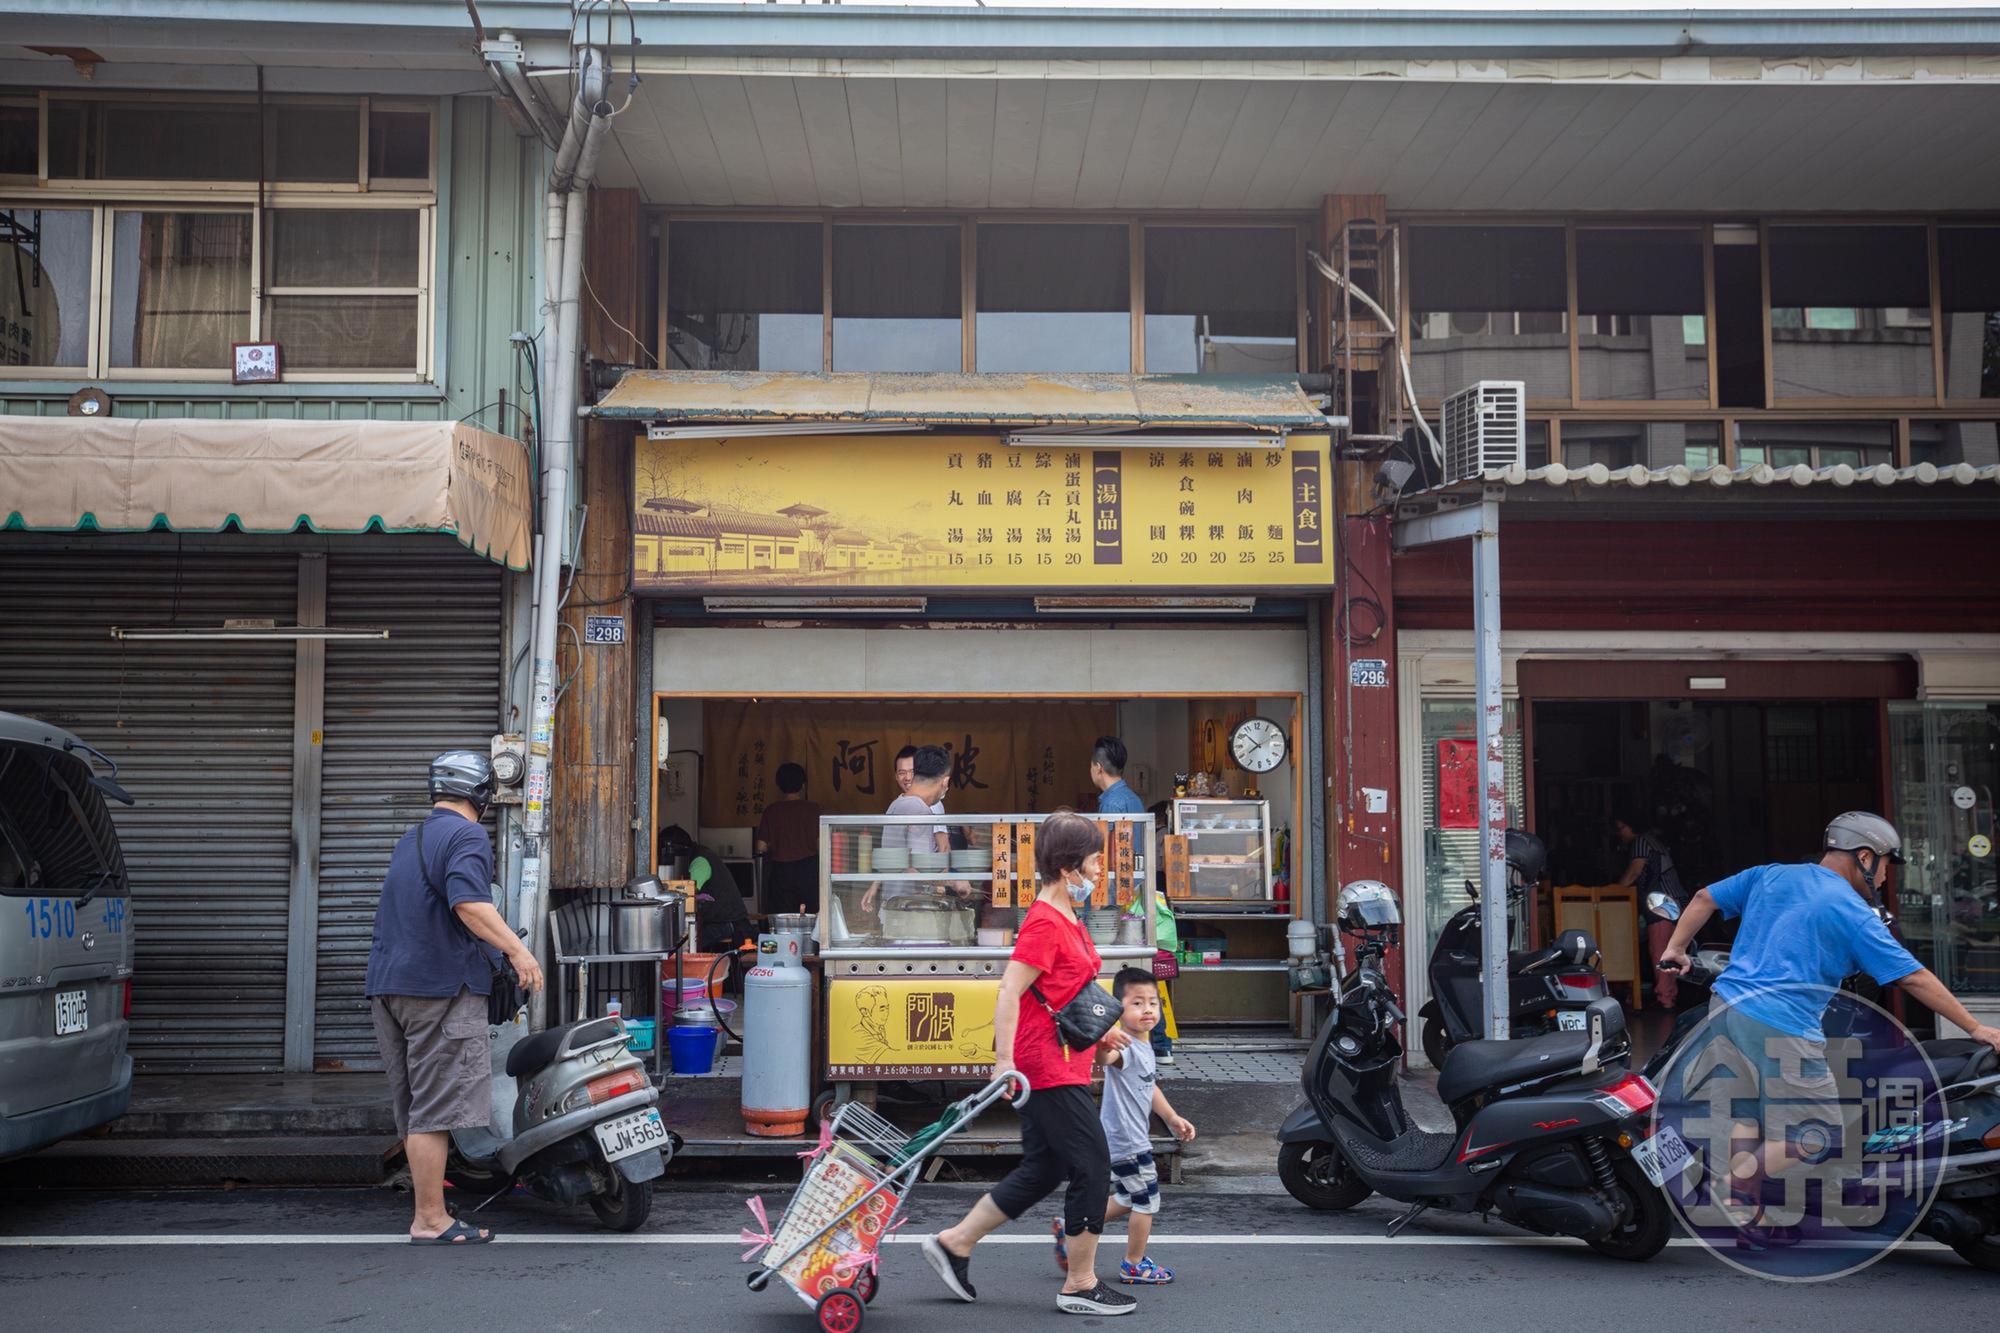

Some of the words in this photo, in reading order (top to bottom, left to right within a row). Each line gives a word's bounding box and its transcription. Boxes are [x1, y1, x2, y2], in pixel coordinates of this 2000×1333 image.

[947, 453, 963, 544] 貢丸湯
[976, 453, 993, 544] 豬血湯
[1006, 453, 1023, 544] 豆腐湯
[1035, 453, 1052, 544] 綜合湯
[1064, 453, 1082, 544] 滷蛋貢丸湯
[1149, 452, 1166, 541] 涼圓
[1178, 452, 1195, 541] 素食碗粿
[1208, 452, 1224, 541] 碗粿
[1237, 452, 1254, 541] 滷肉飯
[949, 553, 963, 565] 15
[978, 553, 993, 565] 15
[1007, 553, 1023, 565] 15
[1037, 553, 1052, 565] 15
[1065, 553, 1082, 565] 20
[1151, 551, 1168, 564] 20
[1181, 551, 1197, 564] 20
[1210, 551, 1227, 564] 20
[1239, 551, 1256, 564] 25
[1268, 551, 1285, 564] 25
[596, 627, 621, 641] 298
[1360, 671, 1385, 684] 296
[996, 833, 1008, 898] 各式湯品
[1118, 831, 1131, 889] 阿波炒麵
[1021, 893, 1034, 903] 20
[26, 898, 75, 939] 1510
